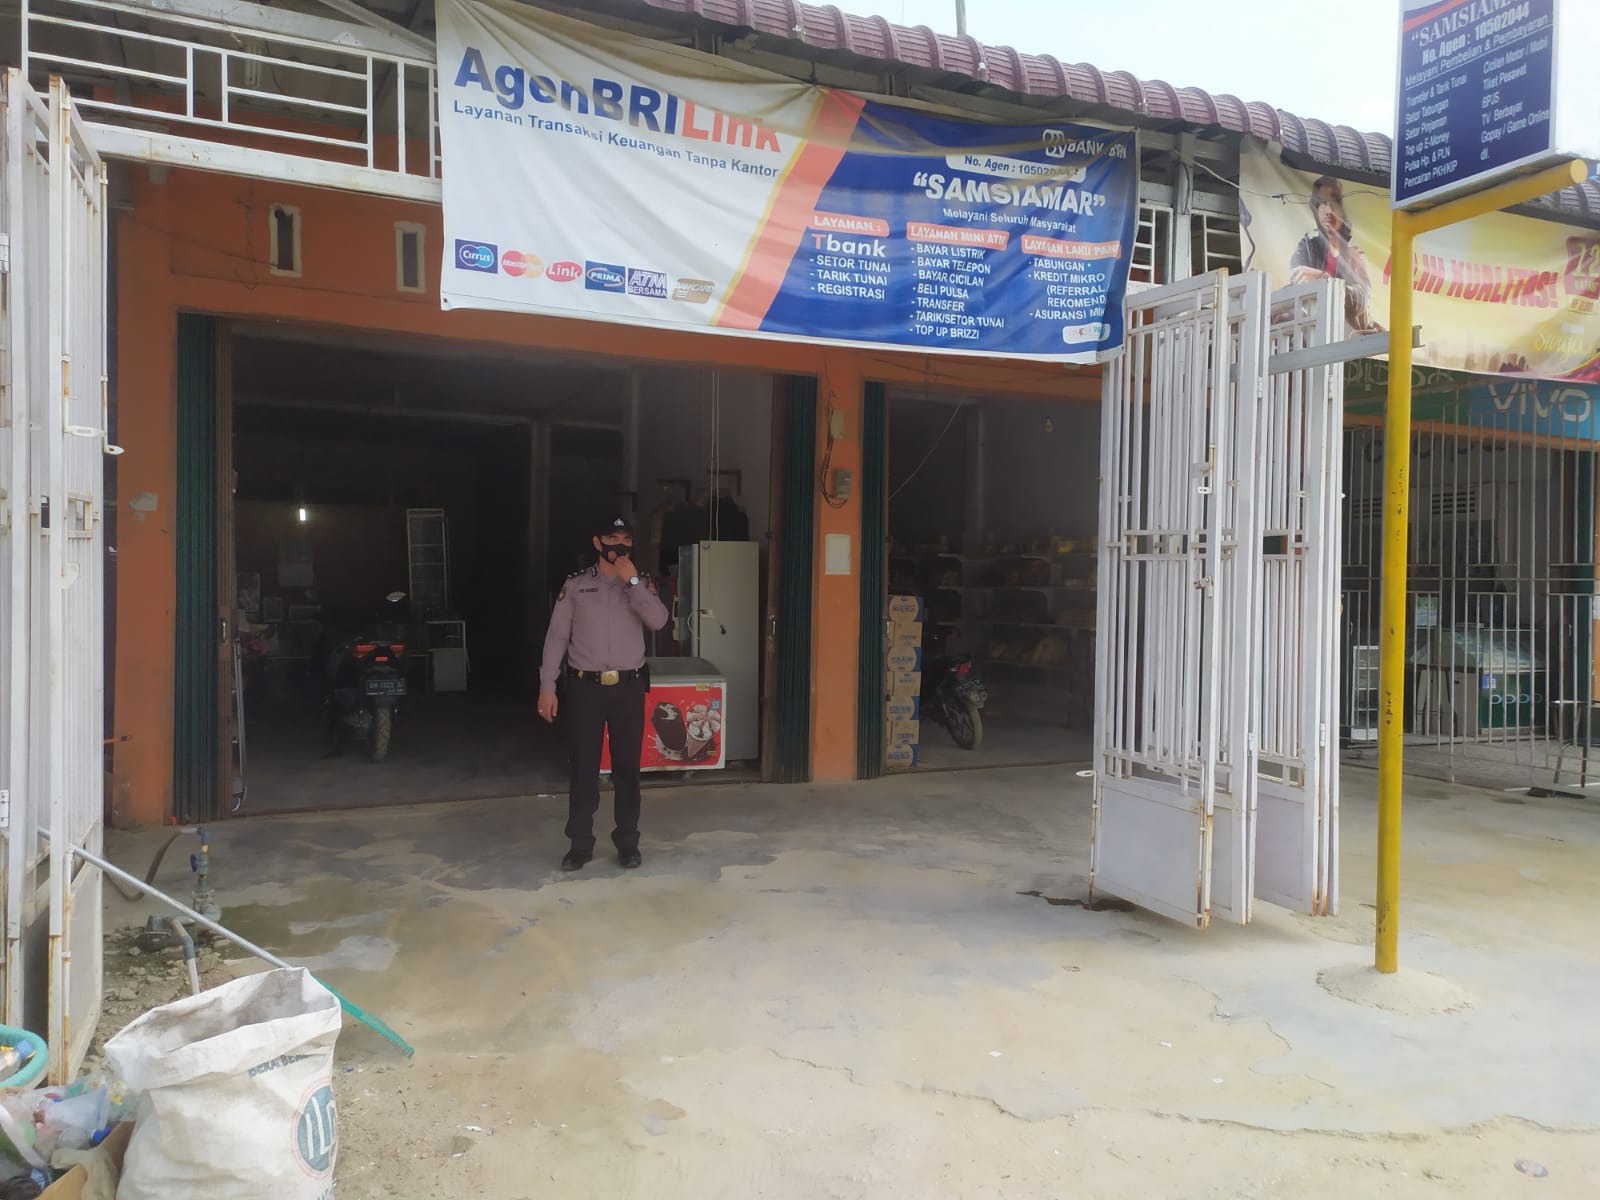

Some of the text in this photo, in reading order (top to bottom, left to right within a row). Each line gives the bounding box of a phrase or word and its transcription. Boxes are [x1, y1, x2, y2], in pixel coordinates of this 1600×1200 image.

[1475, 2, 1529, 42] 10502044
[1405, 61, 1439, 87] Melayani
[1440, 44, 1482, 72] Pembelian
[1493, 14, 1548, 47] Pembayaran
[1506, 47, 1525, 64] Motor
[1451, 72, 1467, 89] Tunai
[1483, 62, 1527, 91] Tiket Pesawat
[1421, 98, 1449, 118] Tabungan
[1482, 91, 1500, 109] BPJS
[1482, 101, 1523, 126] TV Berbayar
[1481, 127, 1502, 143] Gopay
[1507, 117, 1527, 134] Game
[1528, 109, 1550, 126] Online
[454, 99, 779, 178] Layanan Transaksi Keuangan Tanpa Kantor
[964, 155, 981, 167] No.
[984, 157, 1010, 173] Agen
[814, 215, 874, 232] LAYANAN
[943, 207, 1076, 233] Melayani Seluruh Masyarakat
[910, 225, 958, 241] LAYANAN
[961, 230, 984, 243] MINI
[811, 233, 886, 257] Tbank
[916, 243, 986, 260] BAYAR LISTRIK
[1024, 239, 1064, 254] LAYANAN
[1065, 243, 1092, 256] LAKU
[462, 248, 492, 264] Cirrus
[816, 254, 891, 273] SETOR TUNAI
[1033, 257, 1085, 272] TABUNGAN
[547, 263, 580, 280] Link
[917, 256, 991, 275] BAYAR TELEPON
[590, 271, 622, 285] PRIMA
[628, 269, 667, 289] ATM
[816, 268, 888, 286] TARIK TUNAI
[918, 269, 985, 287] BAYAR CICILAN
[1033, 270, 1105, 284] KREDIT MIKRO
[627, 285, 667, 298] BERSAMA
[817, 282, 886, 300] REGISTRASI
[917, 283, 969, 299] BELI PULSA
[1046, 284, 1106, 296] (REFERRAL
[916, 297, 965, 312] TRANSFER
[915, 310, 1005, 328] TARIK/SETOR TUNAI
[1034, 309, 1087, 321] ASURANSI
[914, 324, 980, 340] TOP UP BRIZZI
